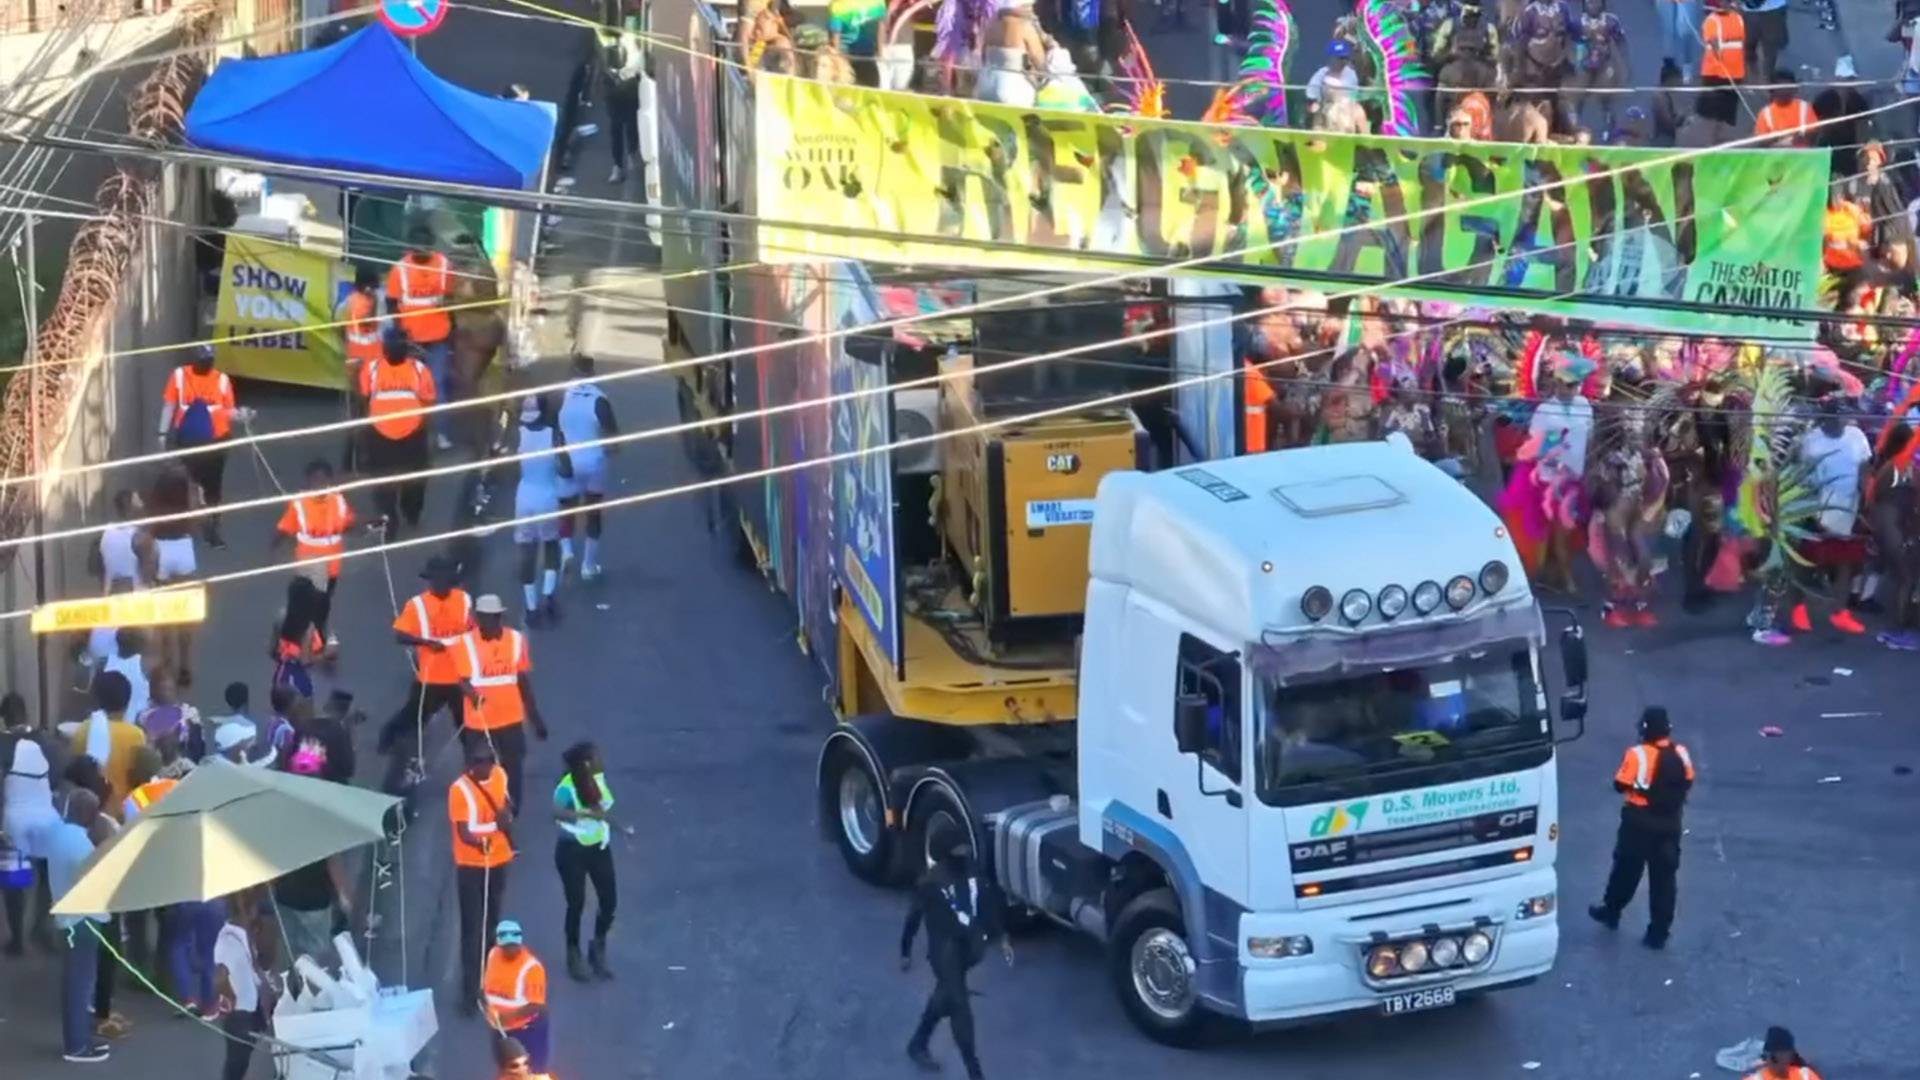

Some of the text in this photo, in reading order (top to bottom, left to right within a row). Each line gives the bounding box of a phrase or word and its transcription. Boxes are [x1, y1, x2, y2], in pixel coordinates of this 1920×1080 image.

[232, 264, 307, 296] SHOW
[1710, 261, 1736, 284] THE
[1782, 268, 1803, 291] OF
[234, 293, 307, 321] YOUR
[1696, 281, 1805, 327] CARNIVAL
[228, 324, 307, 350] LABEL
[1047, 454, 1074, 472] CAT
[1381, 778, 1521, 814] D.S. Movers Ltd.
[1498, 809, 1535, 827] CF
[1293, 841, 1348, 860] DAF
[1383, 986, 1454, 1013] TBY2668
